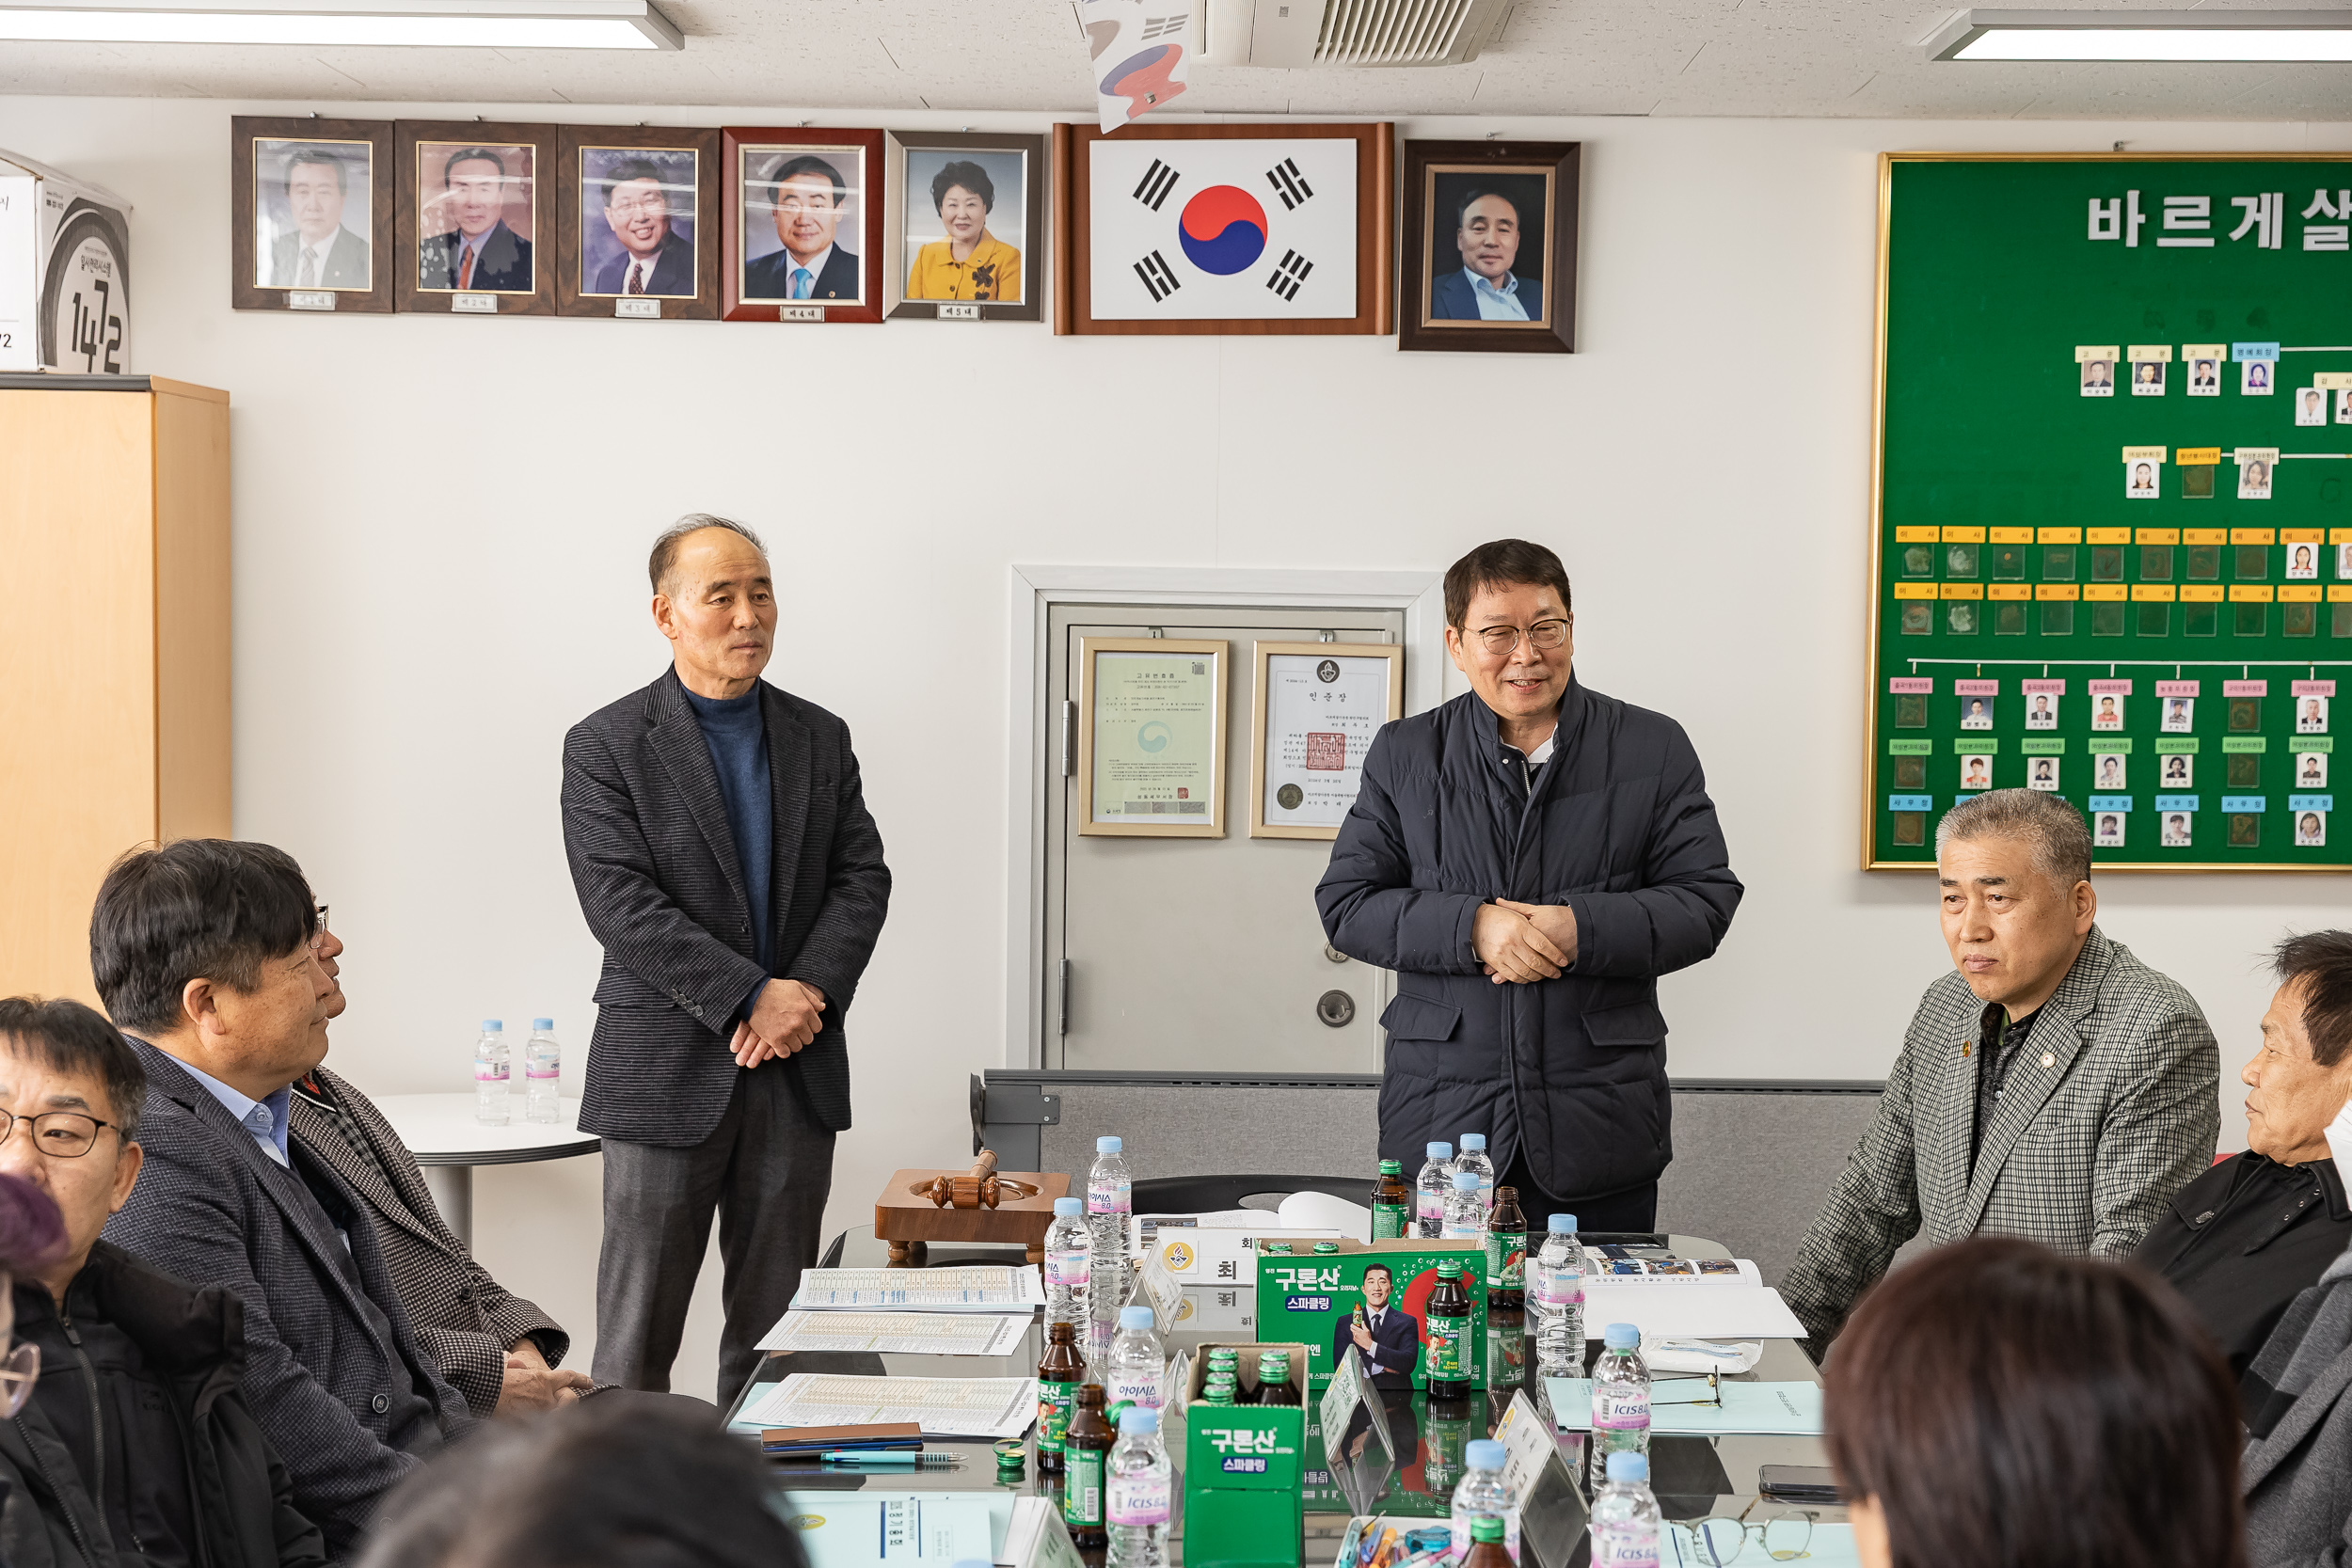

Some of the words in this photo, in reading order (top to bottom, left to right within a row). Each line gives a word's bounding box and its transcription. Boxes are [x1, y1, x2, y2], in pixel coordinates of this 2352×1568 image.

[1310, 691, 1347, 703] 인준장
[1275, 1267, 1340, 1291] 구론산
[1287, 1297, 1329, 1310] 스파클링
[1038, 1383, 1061, 1400] 론산
[1119, 1385, 1157, 1397] 아이시스
[1145, 1396, 1157, 1405] 8.0
[1614, 1404, 1637, 1415] ICIS
[1211, 1428, 1277, 1454] 구론산
[1223, 1458, 1265, 1472] 스파클링
